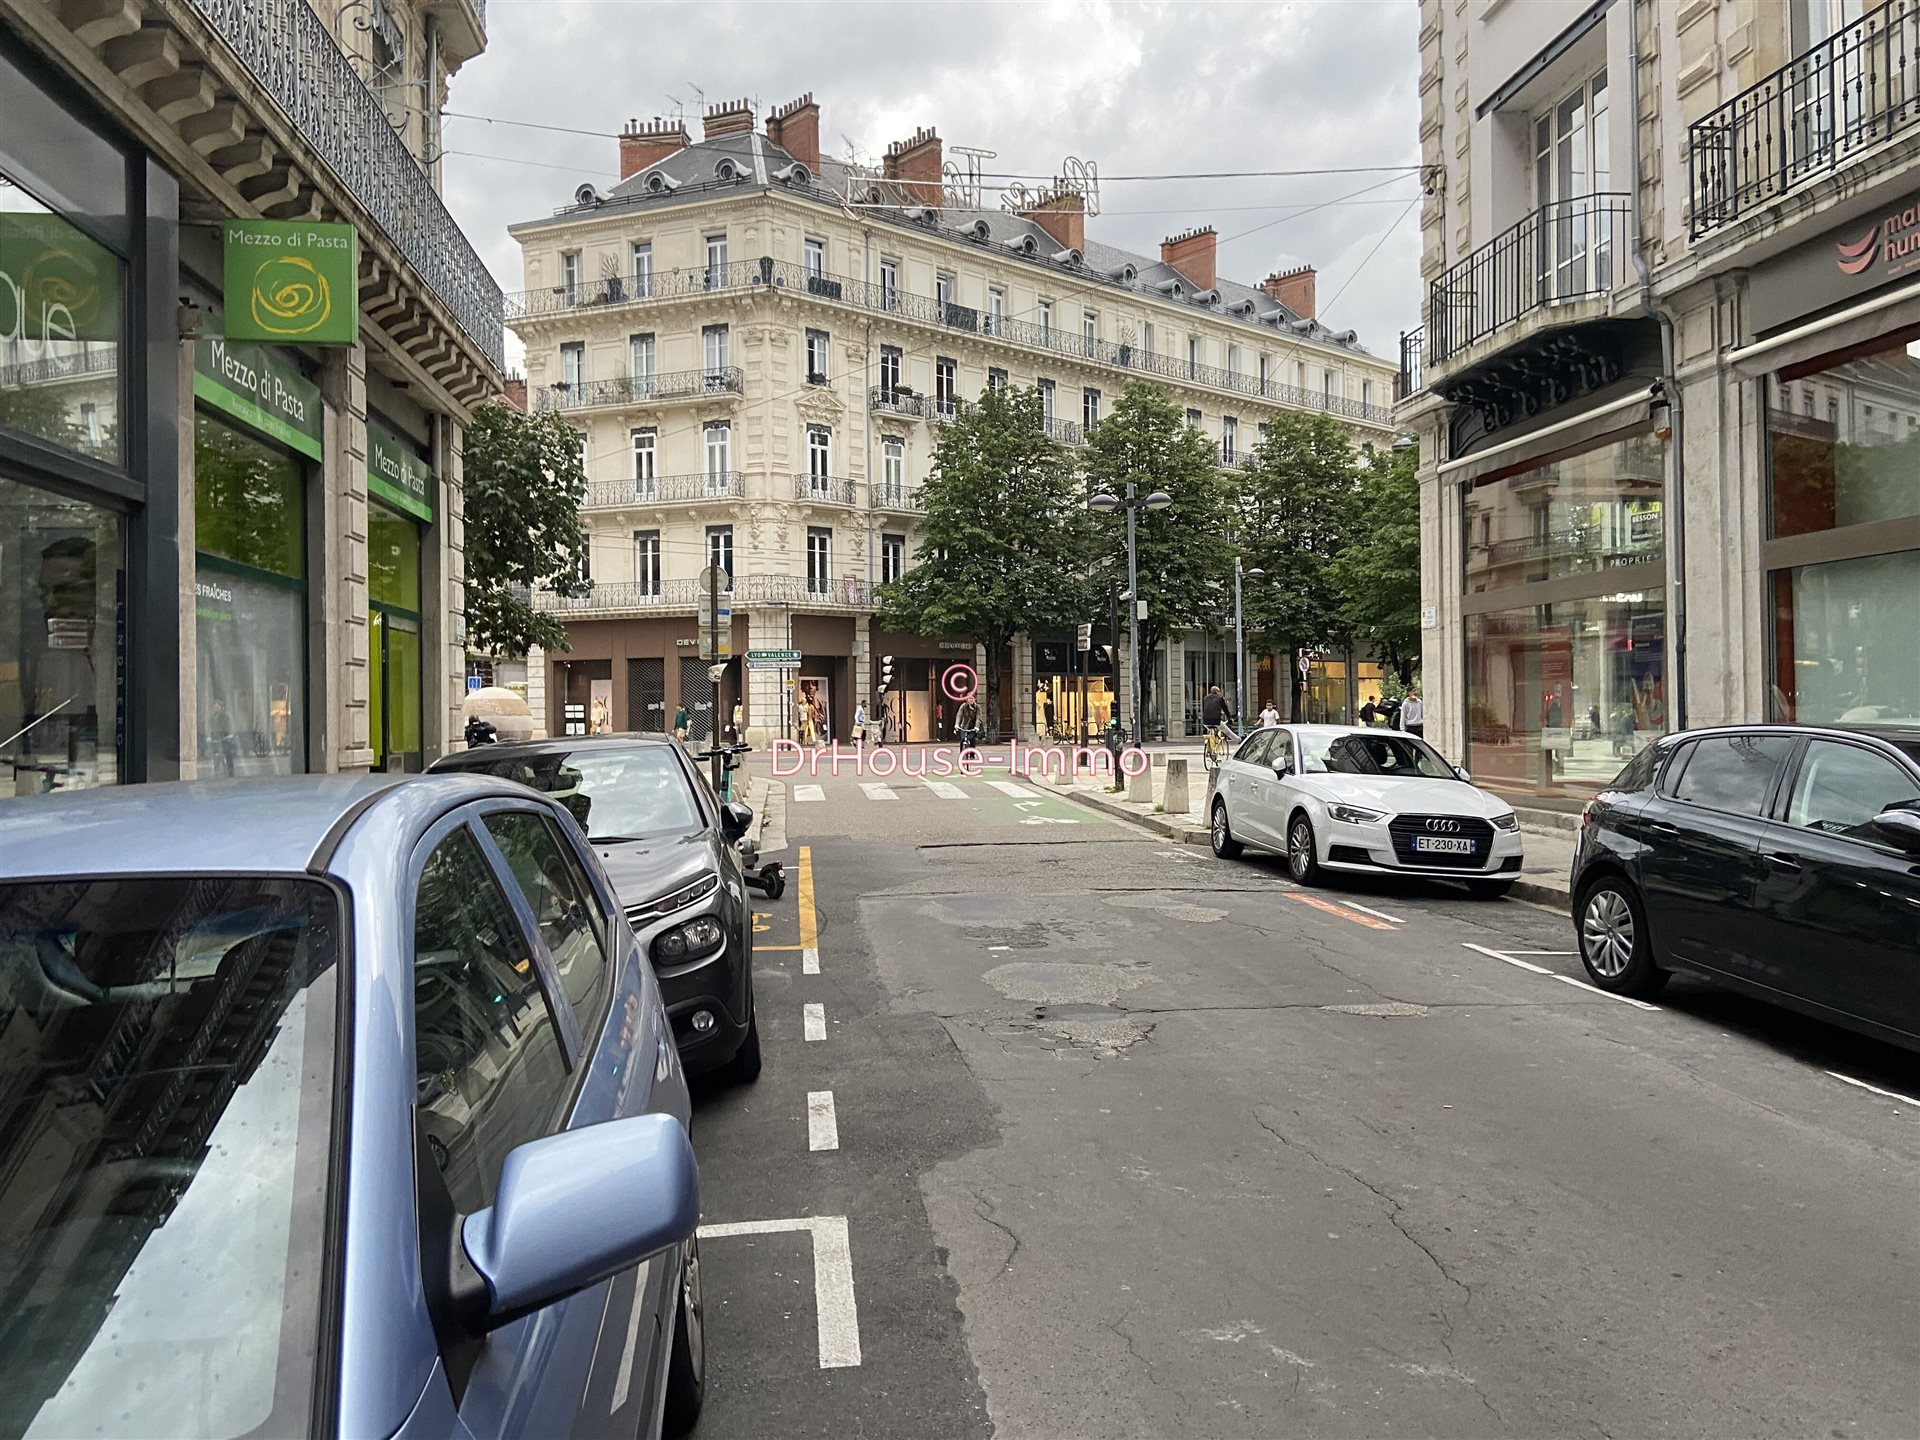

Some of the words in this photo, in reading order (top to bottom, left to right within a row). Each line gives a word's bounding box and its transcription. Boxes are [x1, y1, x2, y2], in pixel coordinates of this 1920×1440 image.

[229, 229, 281, 246] Mezzo
[287, 232, 301, 247] di
[307, 233, 348, 249] Pasta
[211, 340, 257, 392] Mezzo
[260, 370, 271, 402] di
[275, 377, 305, 423] Pasta
[374, 444, 399, 480] Mezzo
[401, 462, 407, 486] di
[408, 465, 425, 496] Pasta
[1418, 838, 1469, 852] ET-230-XA
